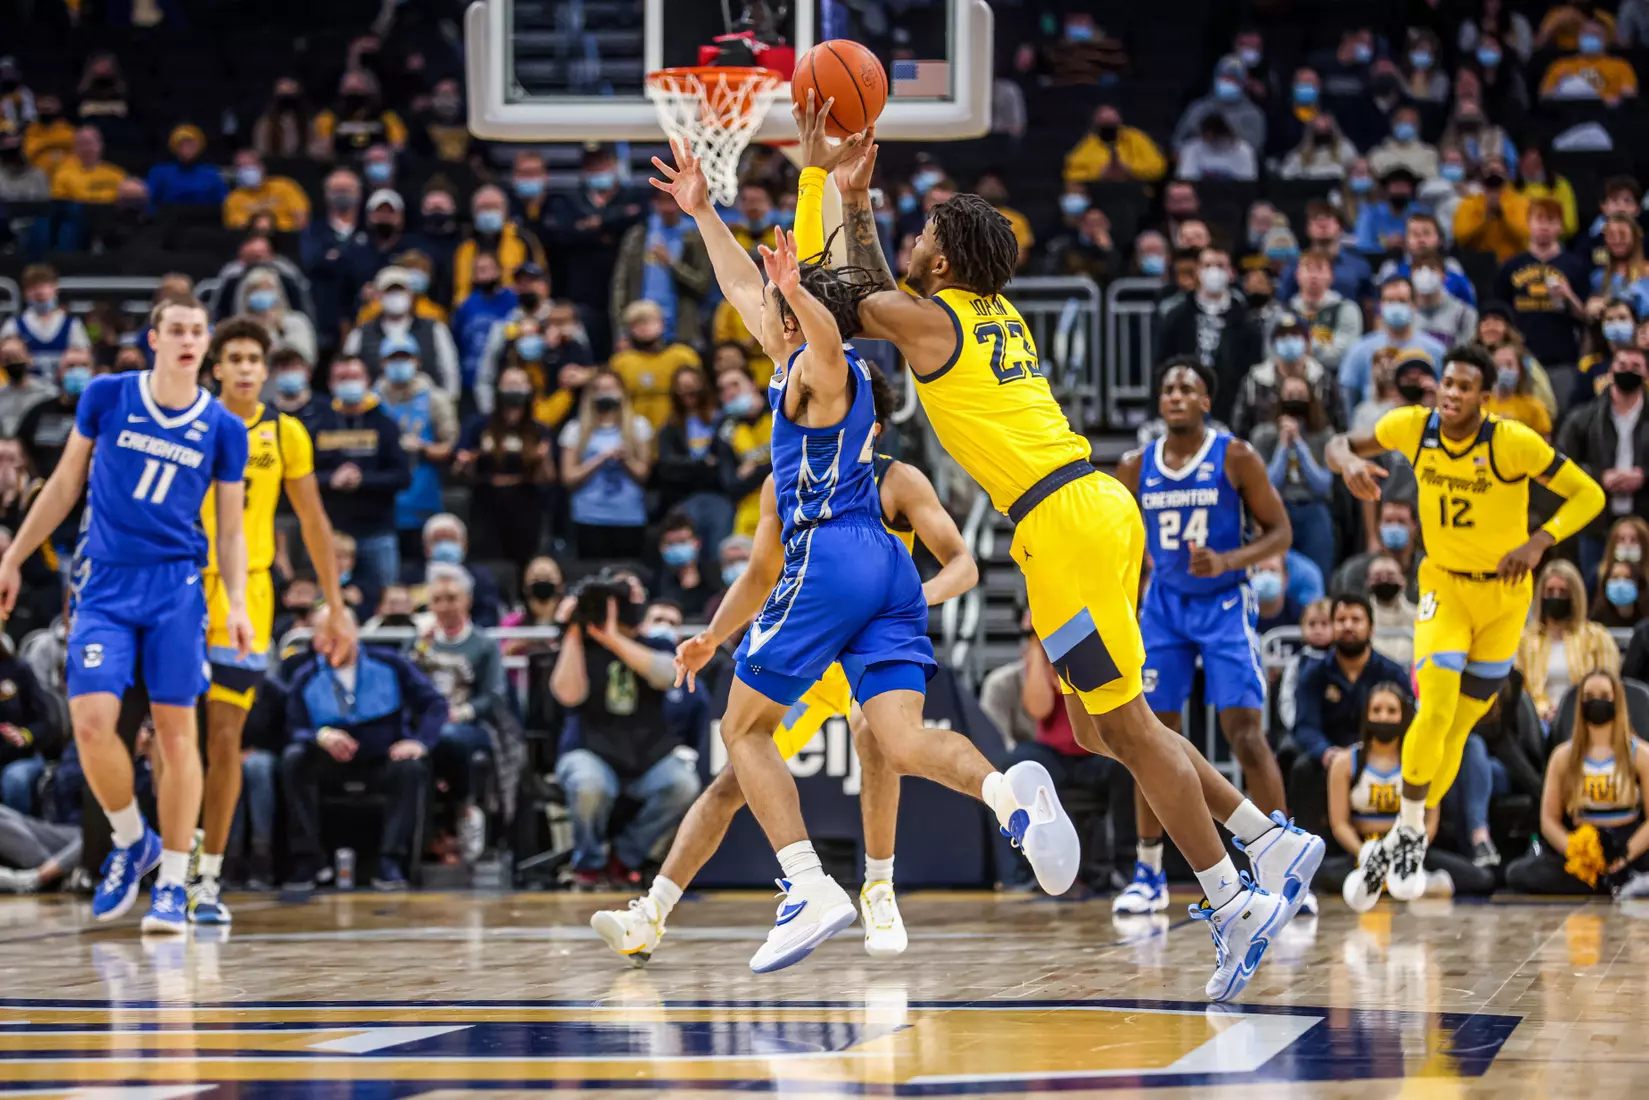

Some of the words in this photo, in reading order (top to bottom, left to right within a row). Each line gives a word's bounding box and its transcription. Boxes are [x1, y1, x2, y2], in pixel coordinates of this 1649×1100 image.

[116, 429, 205, 469] CREIGHTON
[132, 457, 178, 504] 11
[1141, 488, 1219, 510] CREIGHTON
[1158, 508, 1209, 551] 24
[1439, 494, 1475, 529] 12
